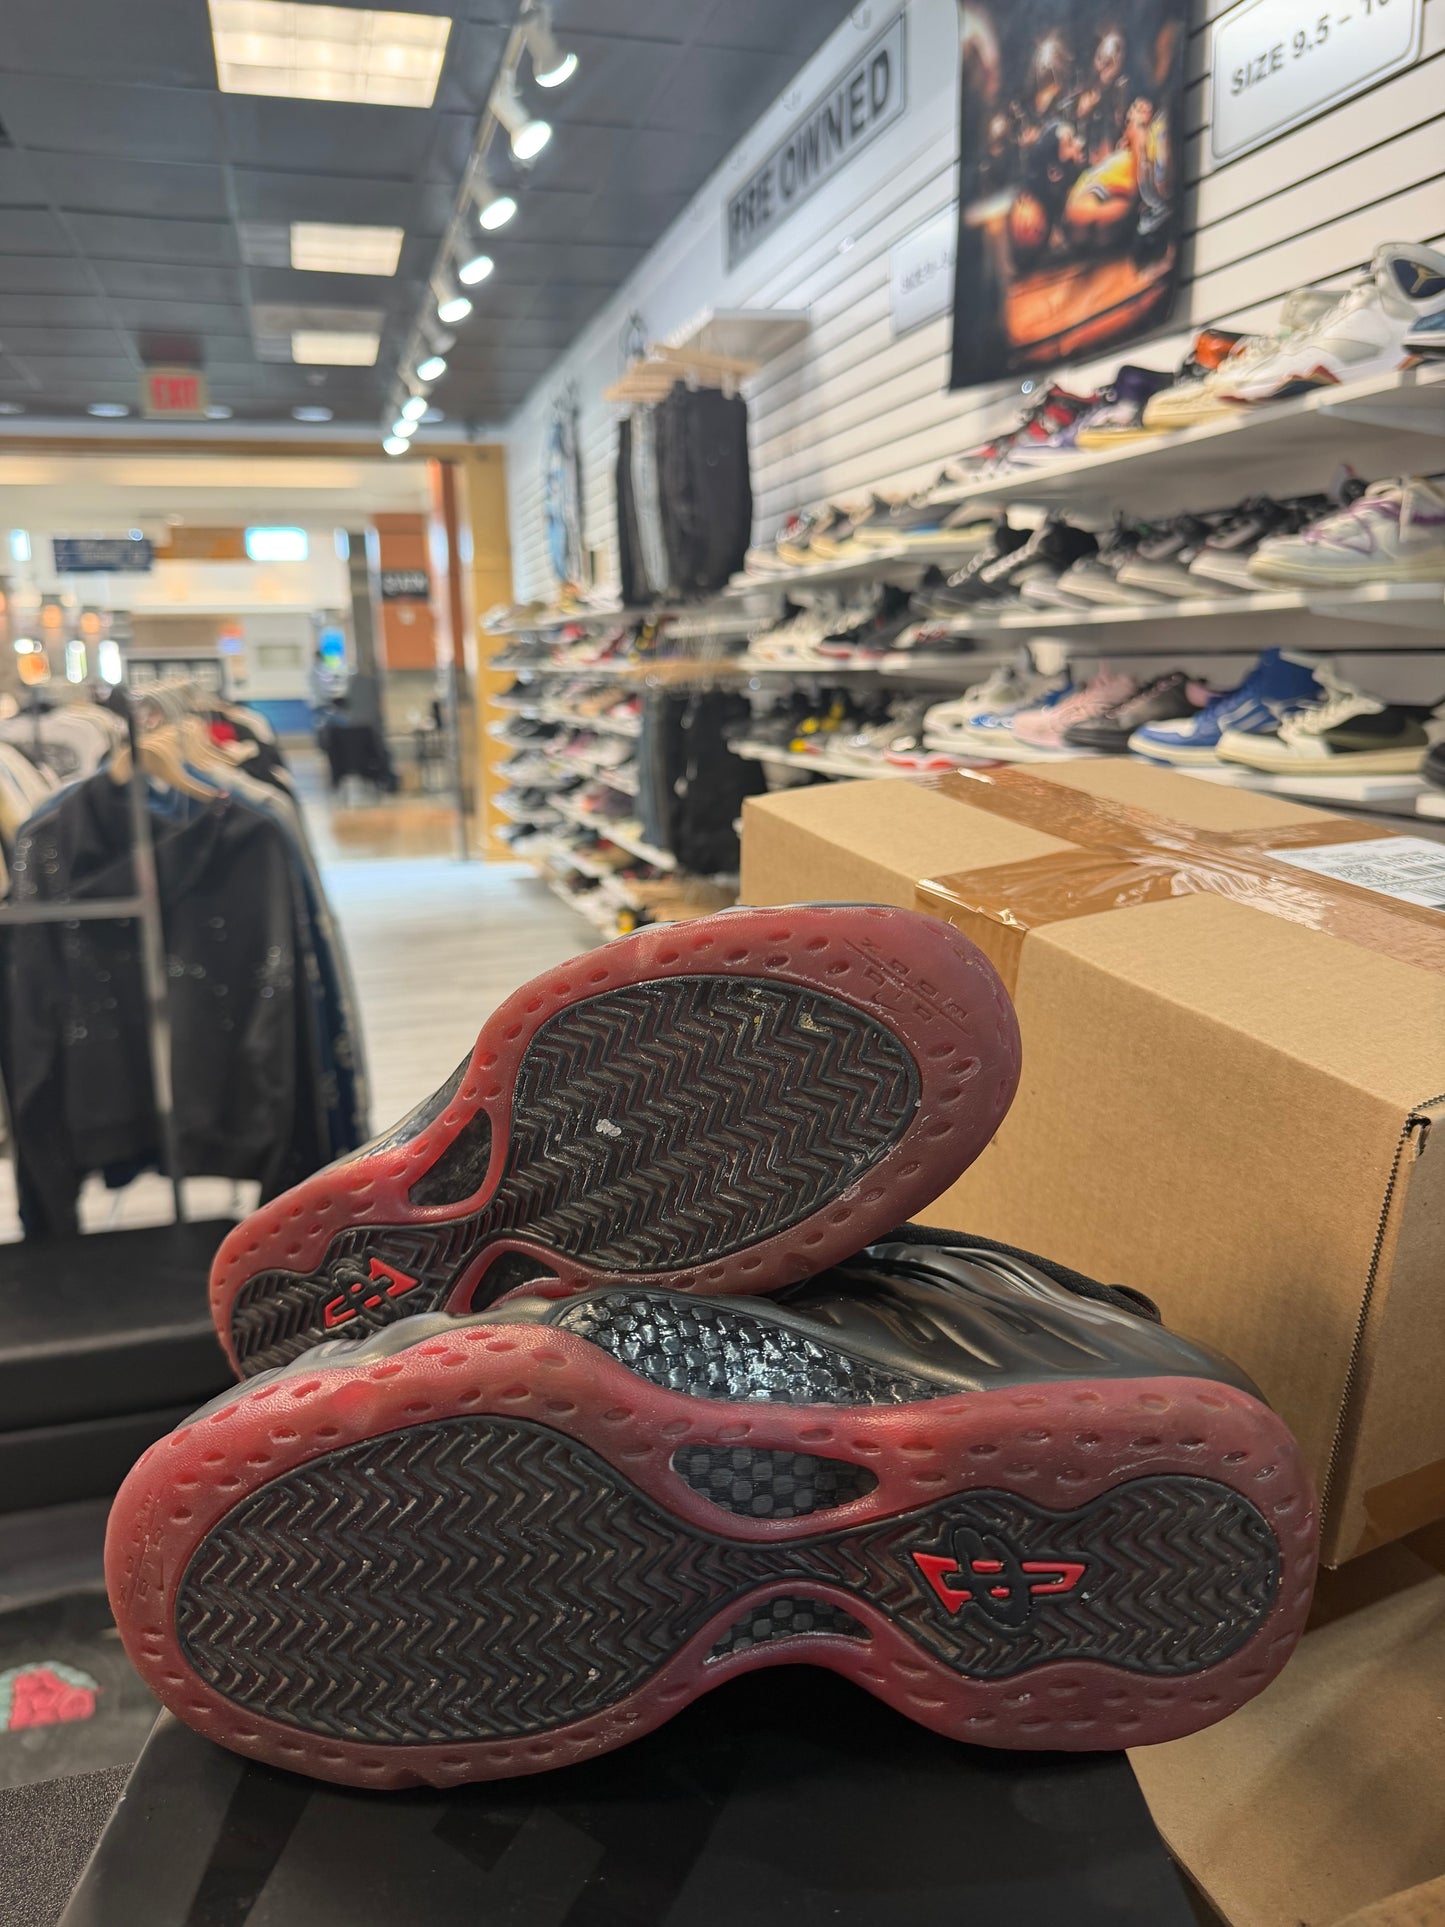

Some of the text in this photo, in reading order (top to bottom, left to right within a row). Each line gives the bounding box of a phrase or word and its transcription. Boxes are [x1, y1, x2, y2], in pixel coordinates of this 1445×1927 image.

[1231, 41, 1285, 97] SIZE
[1293, 14, 1329, 58] 9.5
[779, 48, 890, 201] OWNED
[150, 376, 198, 411] EXIT
